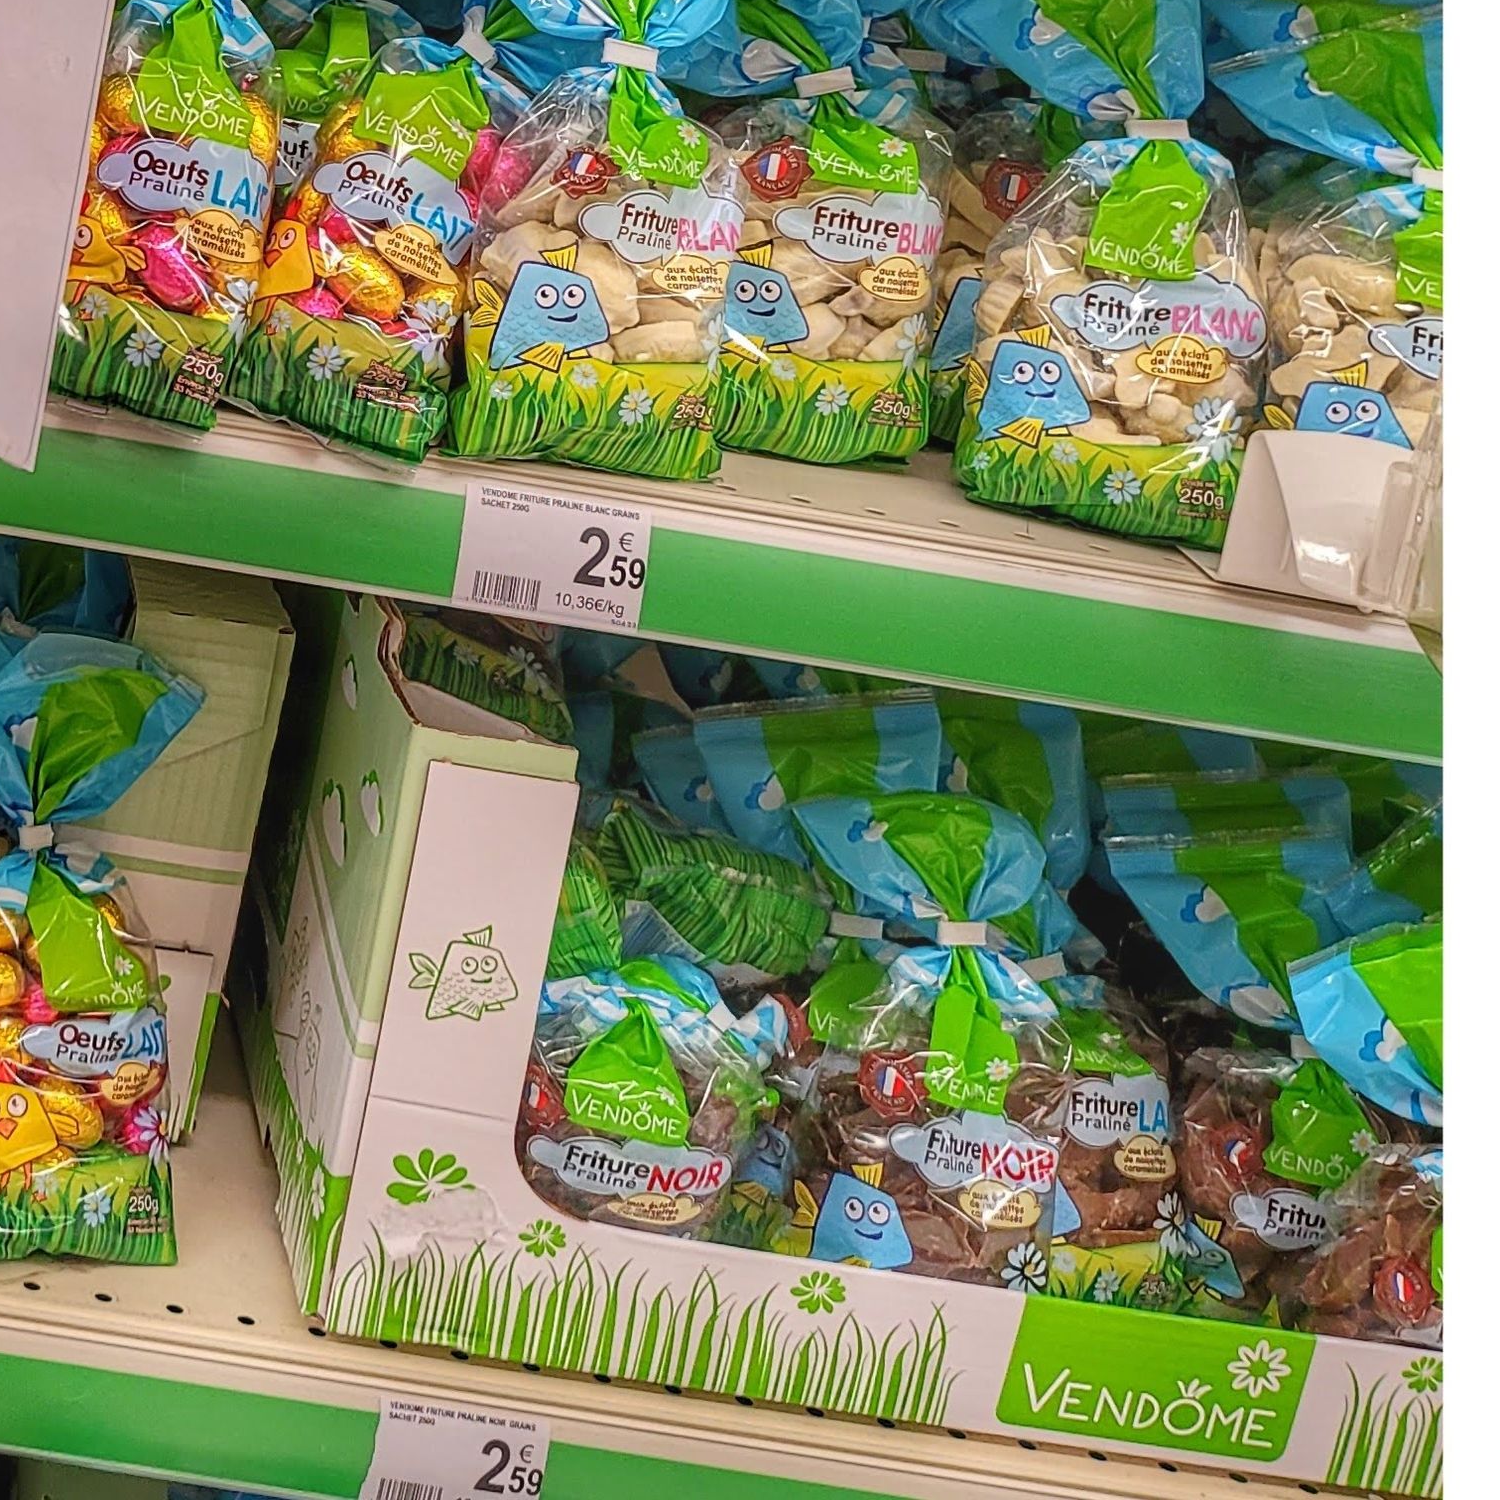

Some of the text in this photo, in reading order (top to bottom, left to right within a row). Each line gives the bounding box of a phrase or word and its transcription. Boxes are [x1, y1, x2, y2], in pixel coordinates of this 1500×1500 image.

[138, 89, 250, 140] VENDÔME
[363, 105, 466, 173] VENDÔME
[129, 172, 206, 202] Praliné
[194, 217, 214, 232] aux
[408, 194, 475, 254] LAIT
[621, 202, 679, 235] Friture
[813, 205, 900, 240] Friture
[616, 226, 672, 251] Praliné
[811, 226, 888, 252] Praliné
[1088, 238, 1188, 277] VENDÔME
[181, 353, 226, 387] 250g
[481, 486, 641, 521] VENDOME FRITURE PRALINE BLANC GRAINS
[481, 497, 531, 513] SACHET 250G
[1178, 486, 1225, 510] 250g
[572, 526, 647, 590] 2 € 59
[555, 592, 625, 619] 10,36€/kg
[571, 1088, 682, 1140] VENDÔME
[1071, 1090, 1140, 1117] Friture
[565, 1143, 724, 1194] Friture NOIR
[981, 1141, 1055, 1183] NOIR
[128, 1195, 160, 1214] 250g
[388, 1411, 418, 1424] SACHET
[389, 1401, 537, 1431] VENDOME FRITURE PRALINE NOIR GRAINS
[1023, 1363, 1277, 1449] VENDÔME
[473, 1438, 544, 1497] 2 € 59
